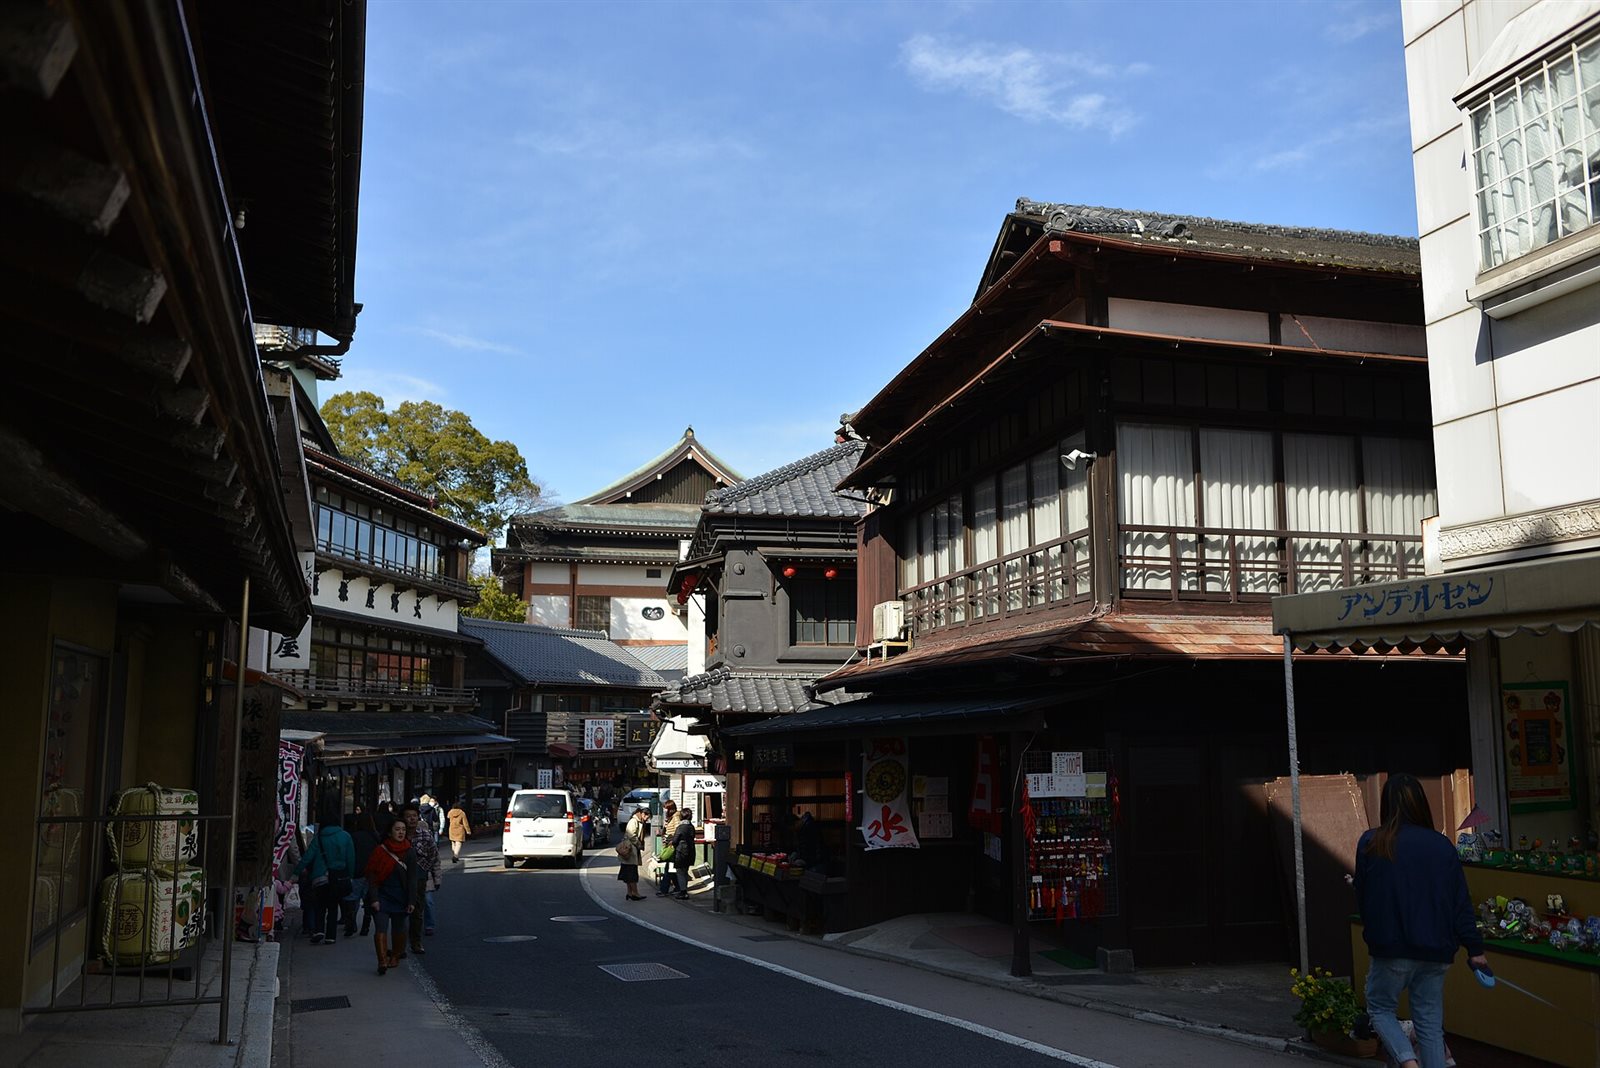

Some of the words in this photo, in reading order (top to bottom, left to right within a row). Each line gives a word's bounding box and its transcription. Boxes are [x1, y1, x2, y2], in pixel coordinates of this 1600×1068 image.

[1338, 578, 1493, 620] アンデルセン
[274, 637, 299, 658] 屋
[867, 804, 908, 842] 水
